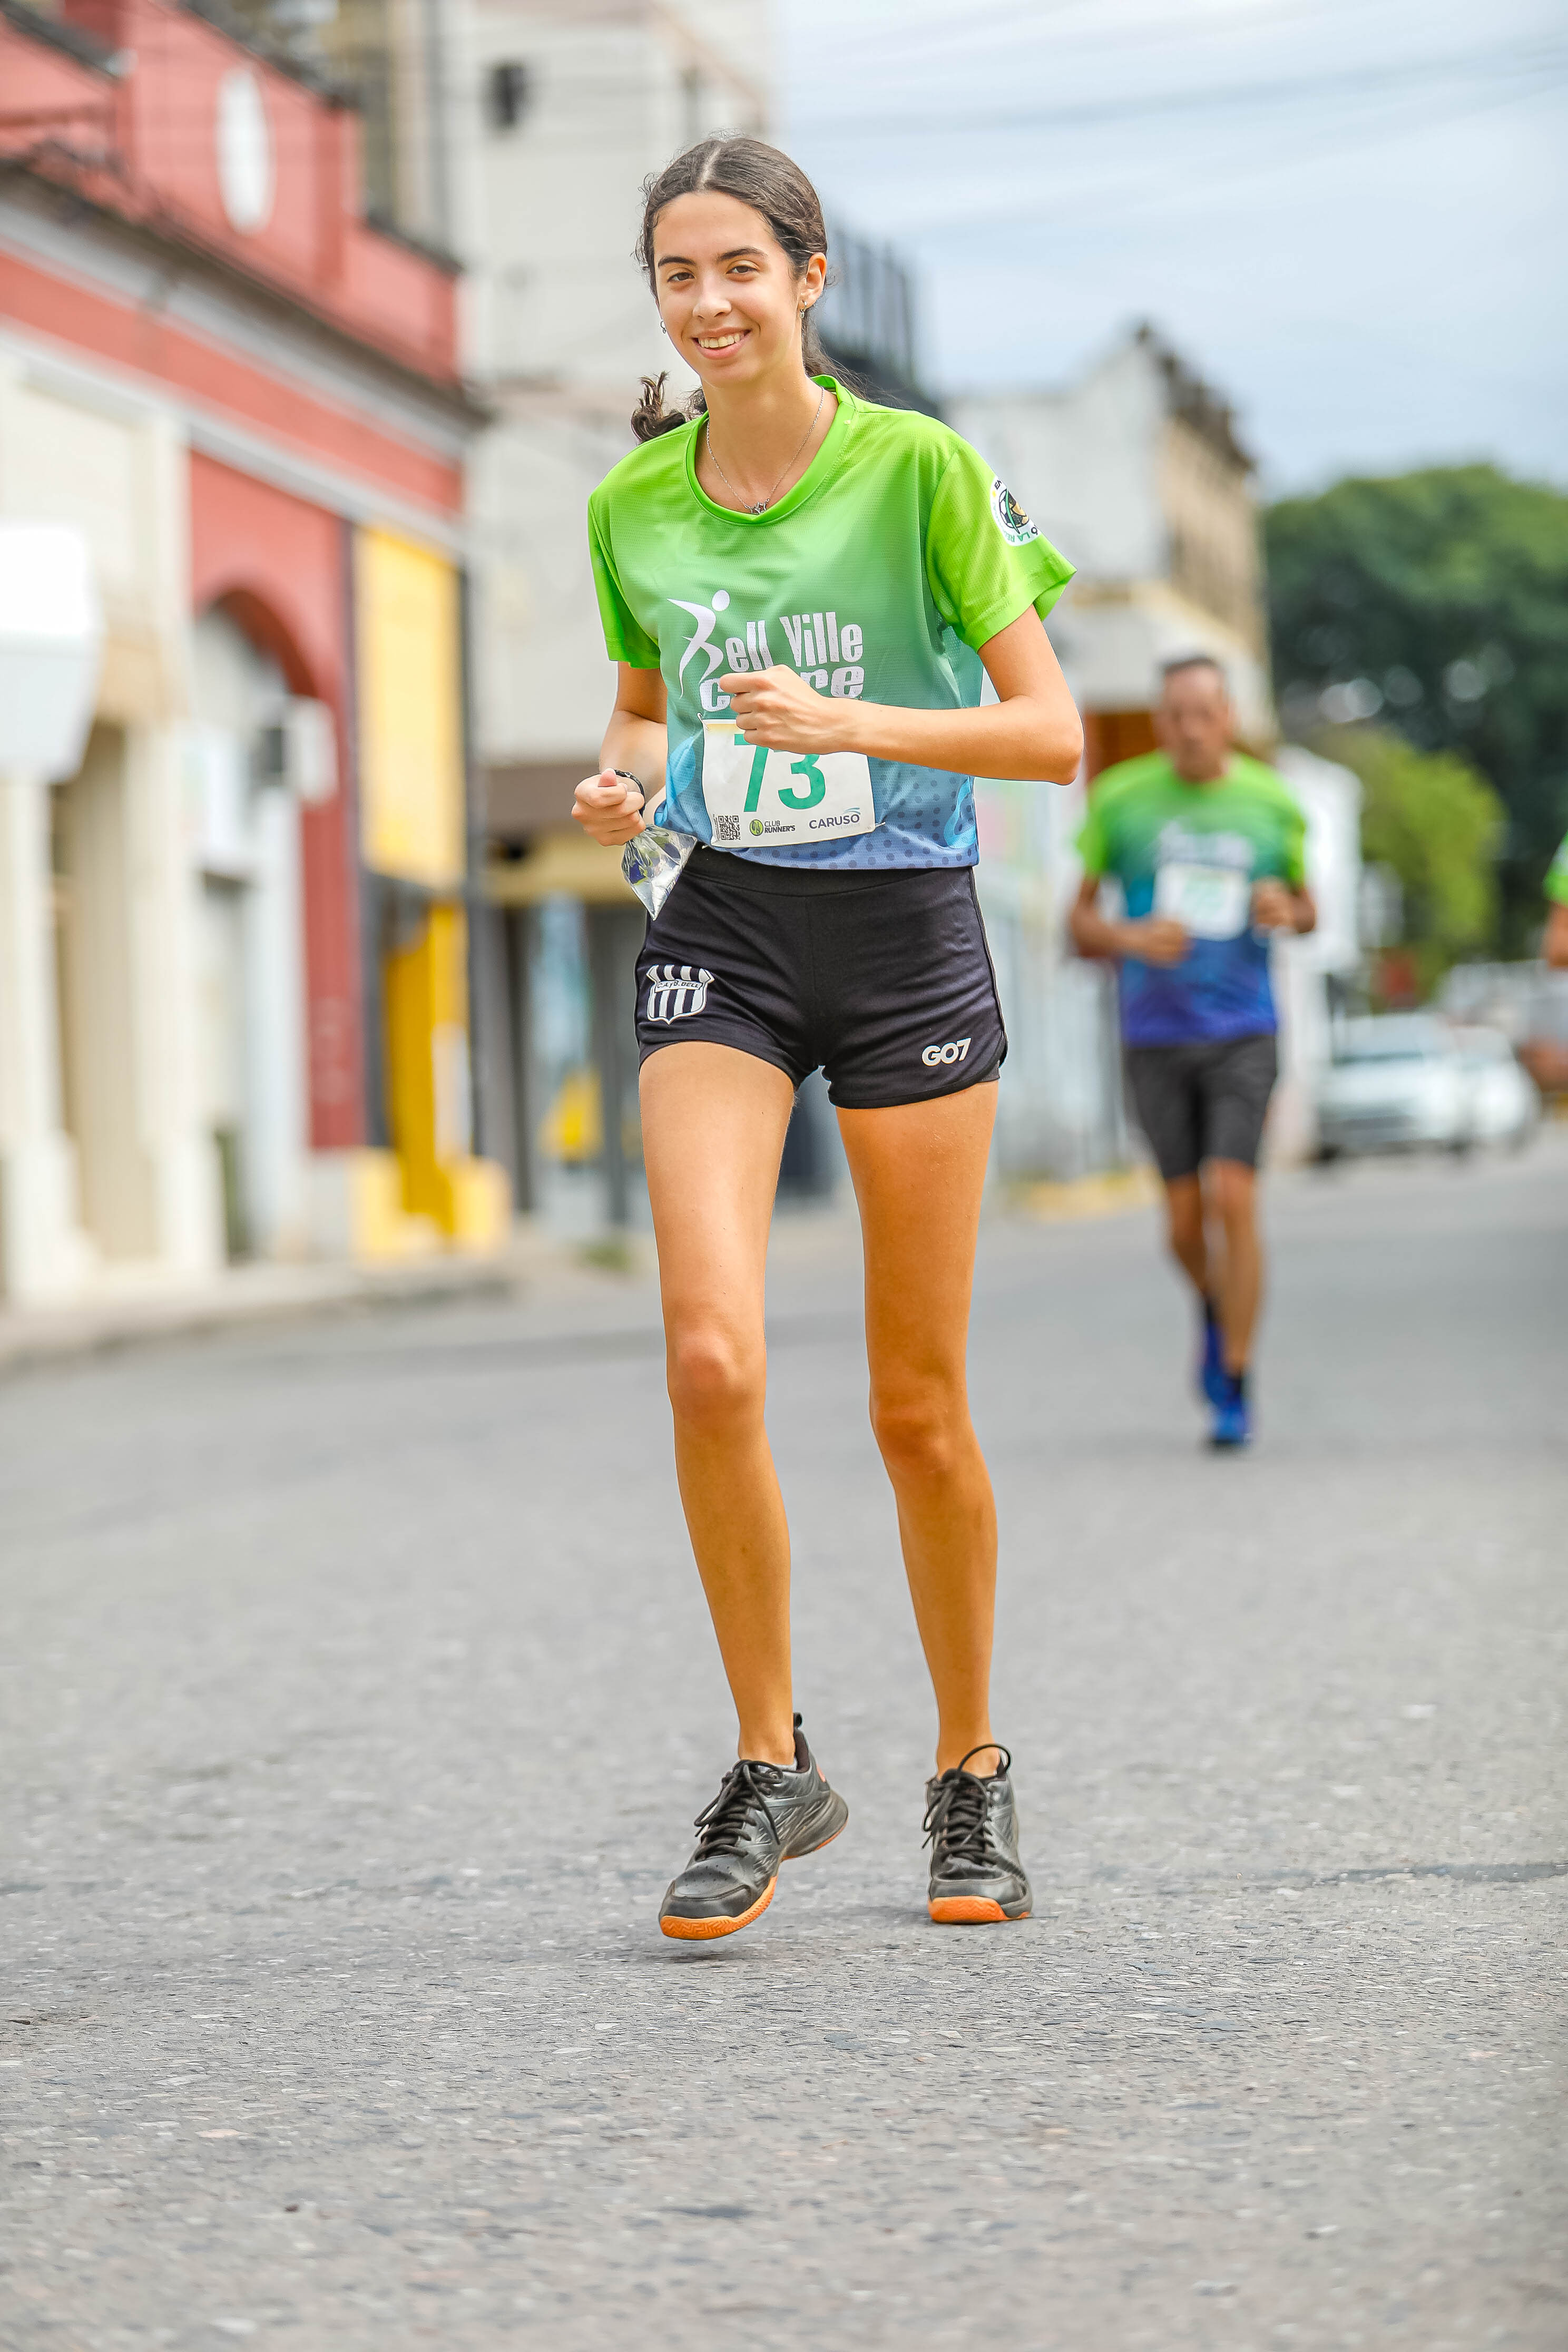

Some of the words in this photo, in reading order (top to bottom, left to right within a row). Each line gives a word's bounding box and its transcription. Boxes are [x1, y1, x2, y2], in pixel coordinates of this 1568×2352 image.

[779, 611, 864, 667] Ville
[699, 665, 865, 711] cre
[734, 733, 826, 812] 73
[764, 825, 796, 834] RUNNER'S
[809, 814, 860, 829] CARUSO
[922, 1037, 972, 1066] GO7
